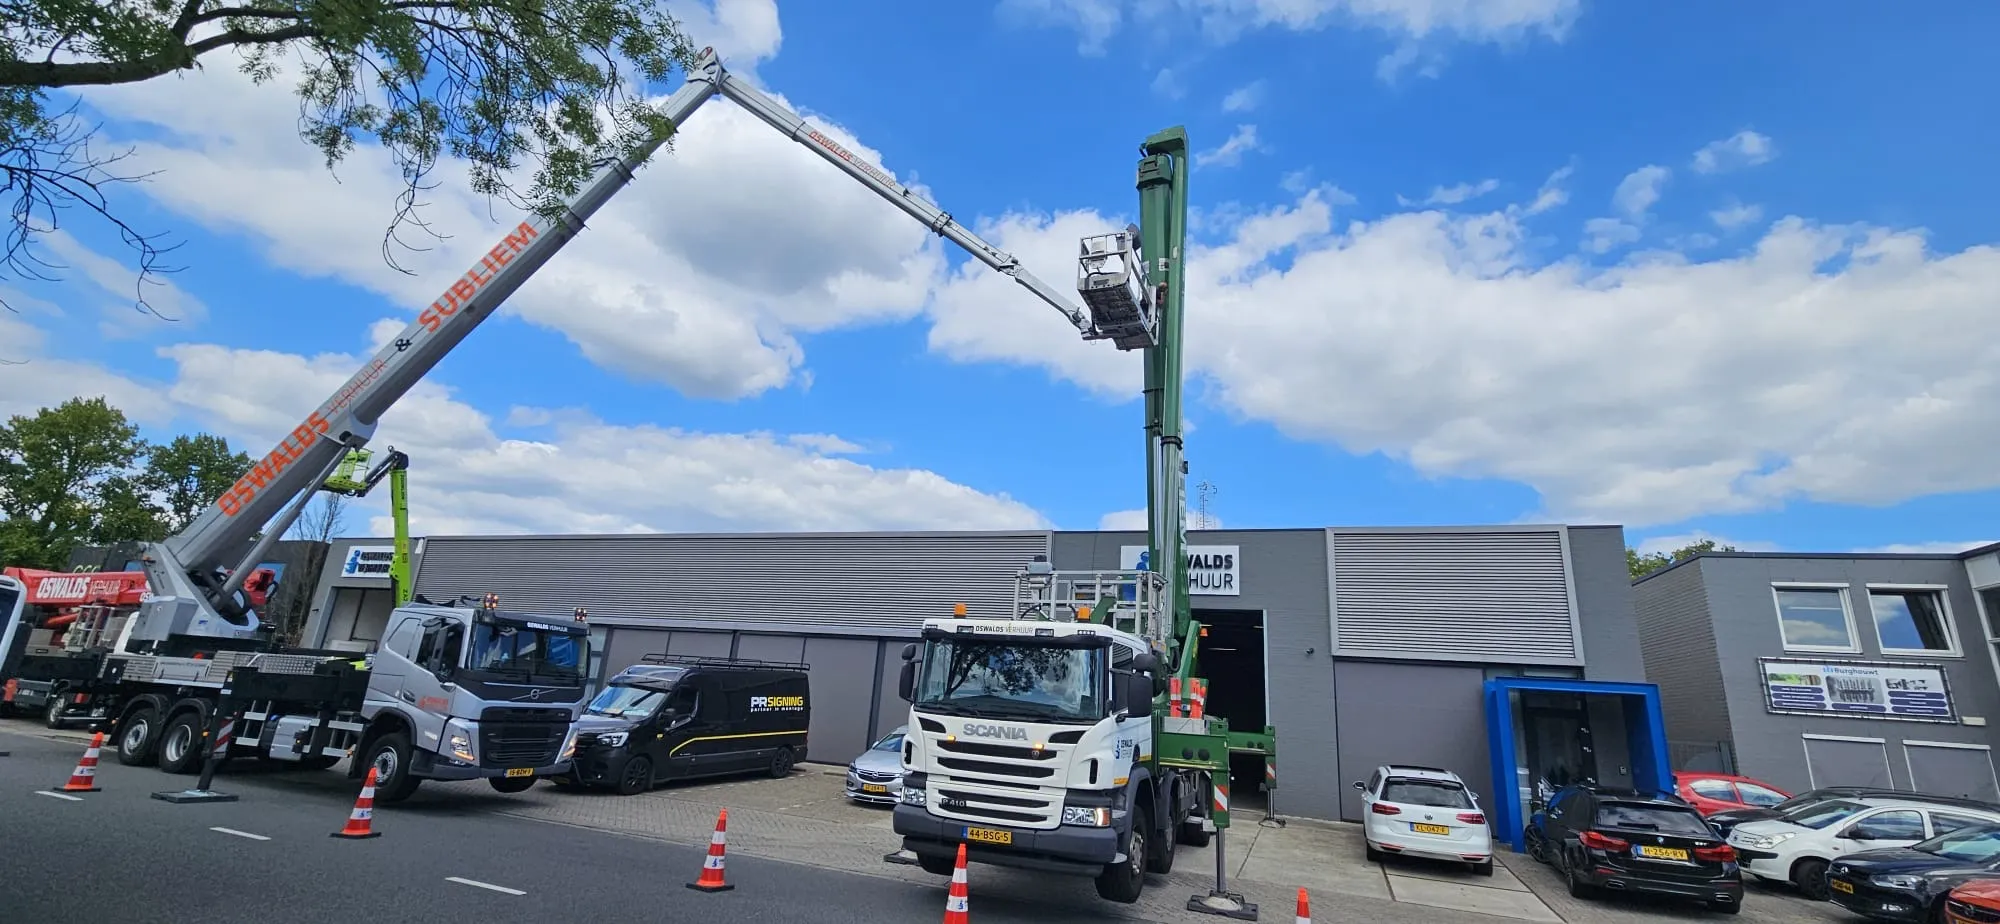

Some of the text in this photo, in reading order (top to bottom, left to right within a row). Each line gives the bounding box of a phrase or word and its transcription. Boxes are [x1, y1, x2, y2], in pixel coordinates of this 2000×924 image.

[808, 129, 852, 161] OSWALDS
[218, 221, 538, 517] OSWALDS VERHUUR & SUBLIEM
[36, 577, 91, 599] OSWALDS
[1189, 572, 1233, 589] HUUR
[975, 625, 1004, 633] OSWALDS
[963, 723, 1028, 741] SCANIA
[968, 829, 1010, 842] 44-BSG-5
